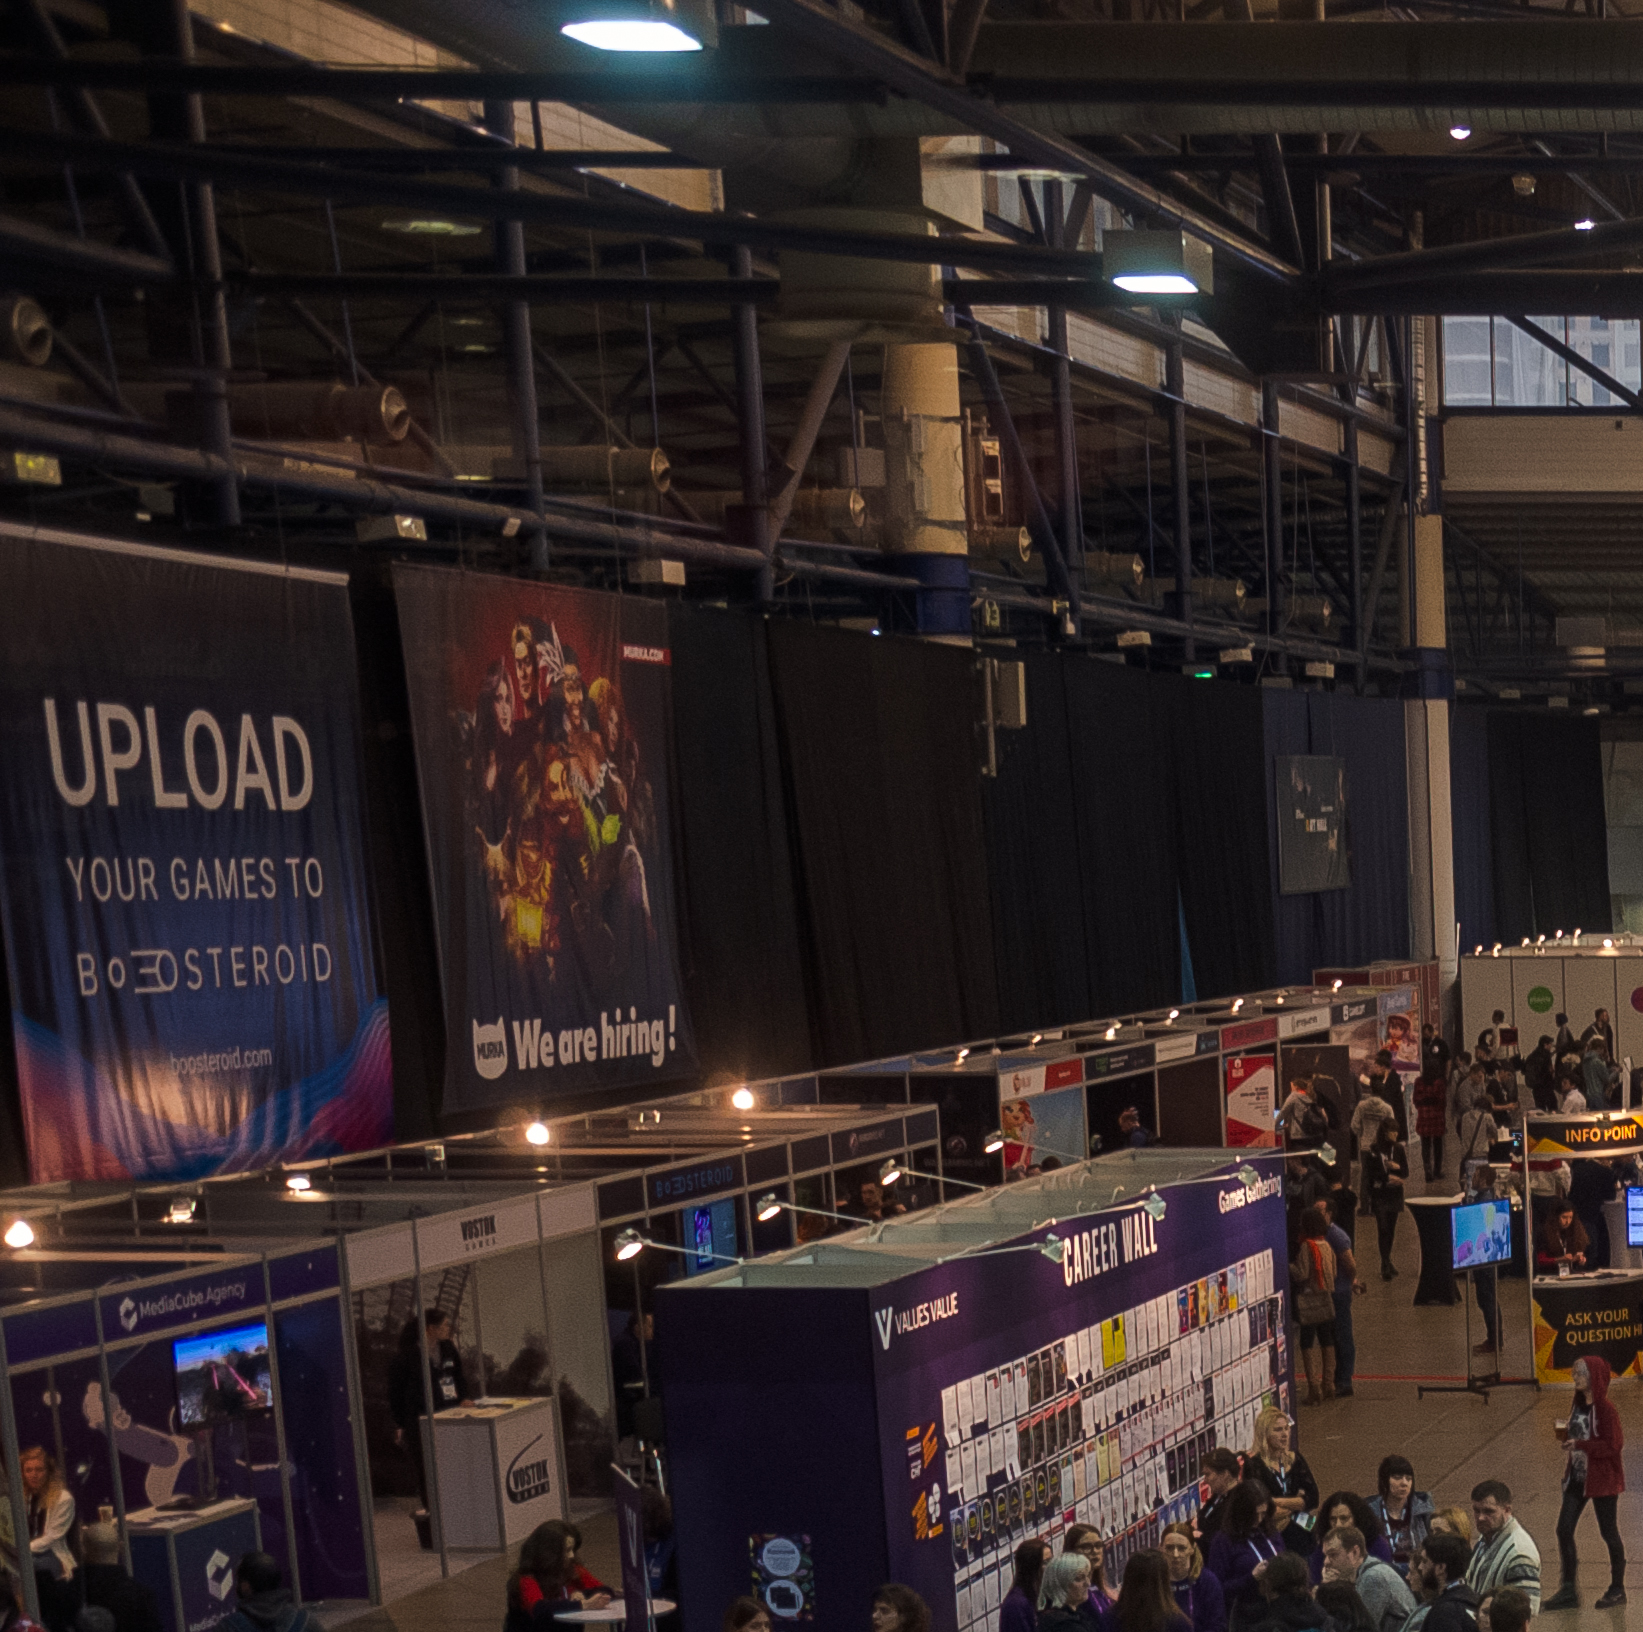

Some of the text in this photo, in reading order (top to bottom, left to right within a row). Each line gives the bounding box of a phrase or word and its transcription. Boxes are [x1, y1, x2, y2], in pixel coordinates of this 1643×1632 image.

[43, 695, 314, 812] UPLOAD
[66, 856, 325, 903] YOUR GAMES TO
[512, 1017, 555, 1070] We
[558, 1026, 598, 1066] are
[170, 1046, 273, 1078] boosteroid.com
[1565, 1124, 1637, 1143] INFO POINT
[1218, 1188, 1246, 1216] Games
[461, 1215, 496, 1241] VOSTOK
[1063, 1210, 1158, 1288] CAREER WALL
[139, 1283, 246, 1318] MediaCube Agency
[895, 1292, 959, 1335] VALUES VALUE
[1565, 1308, 1629, 1326] ASK YOUR
[1566, 1326, 1631, 1346] QUESTION
[512, 1459, 548, 1491] VOSTOK
